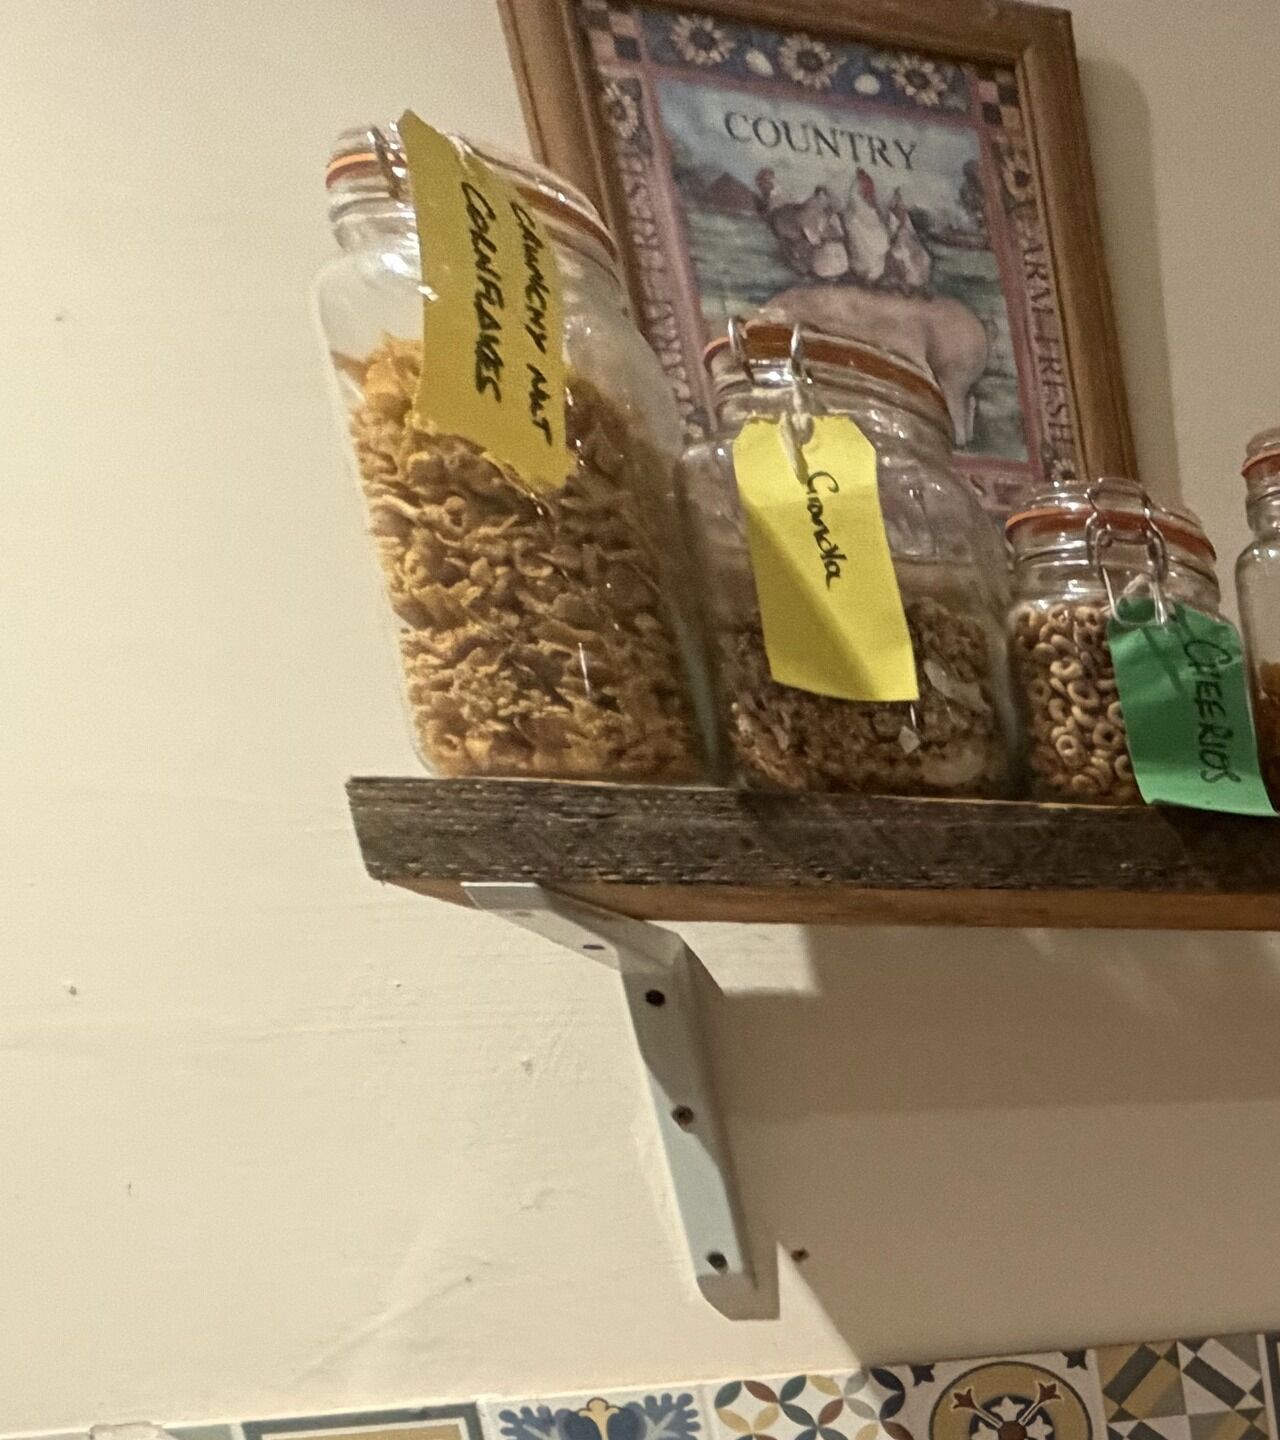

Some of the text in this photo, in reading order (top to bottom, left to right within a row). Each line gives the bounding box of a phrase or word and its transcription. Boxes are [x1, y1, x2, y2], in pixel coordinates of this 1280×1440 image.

[724, 109, 919, 173] COUNTRY
[461, 180, 504, 404] CORNFLAKES
[526, 362, 553, 447] NUT
[1184, 639, 1242, 783] CHEERIOS
